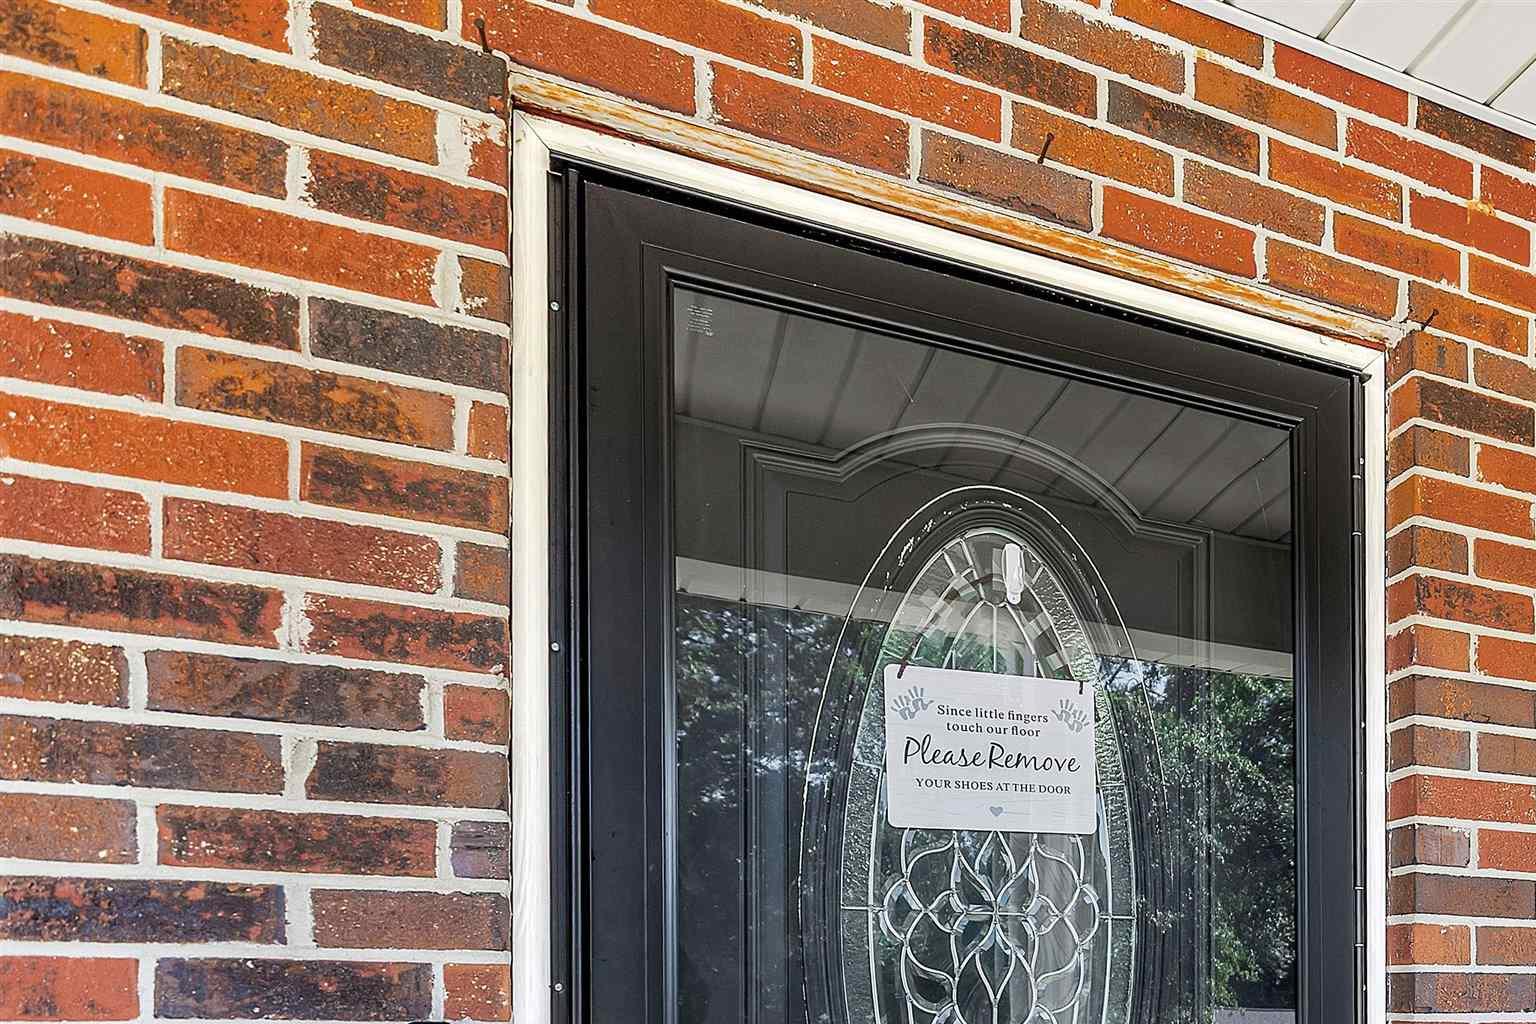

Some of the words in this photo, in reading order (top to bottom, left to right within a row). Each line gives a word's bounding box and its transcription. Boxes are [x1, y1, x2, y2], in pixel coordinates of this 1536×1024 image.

[937, 704, 972, 717] Since
[975, 708, 1005, 720] little
[1007, 710, 1049, 724] fingers
[946, 722, 983, 734] touch
[986, 726, 1010, 735] our
[1011, 726, 1041, 737] floor
[904, 734, 986, 767] Please
[988, 742, 1081, 773] Remove
[915, 778, 952, 790] YOUR
[954, 780, 994, 791] SHOES
[995, 783, 1011, 792] AT
[1012, 783, 1036, 793] THE
[1038, 784, 1072, 795] DOOR
